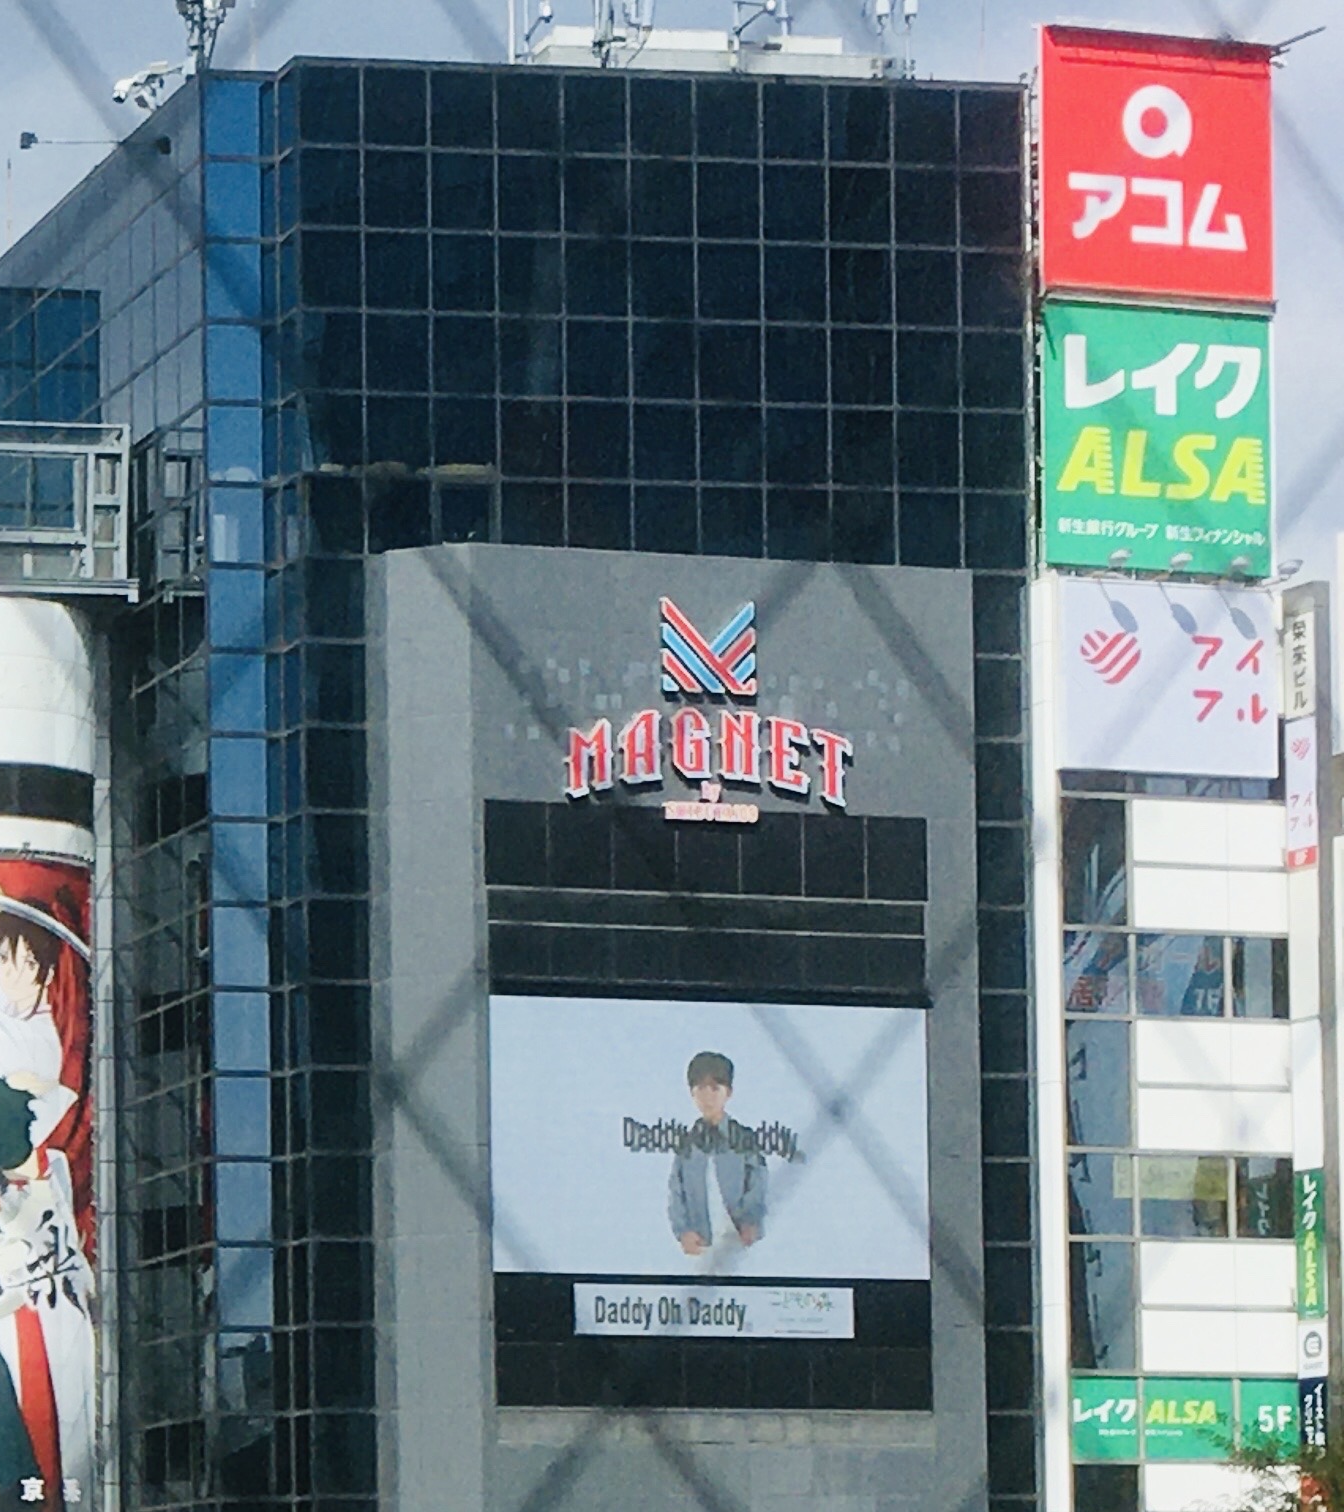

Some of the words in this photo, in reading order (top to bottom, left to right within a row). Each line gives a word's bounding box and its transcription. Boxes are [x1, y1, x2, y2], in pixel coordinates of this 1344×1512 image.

[1068, 171, 1248, 251] アコム
[1064, 334, 1261, 419] レイク
[1056, 426, 1266, 505] ALSA
[564, 707, 853, 808] MAGNET
[594, 1295, 653, 1330] Daddy
[657, 1296, 681, 1325] Oh
[688, 1297, 747, 1331] Daddy
[1073, 1398, 1137, 1422] レイク
[1145, 1400, 1217, 1425] ALSA
[1257, 1405, 1292, 1433] 5F
